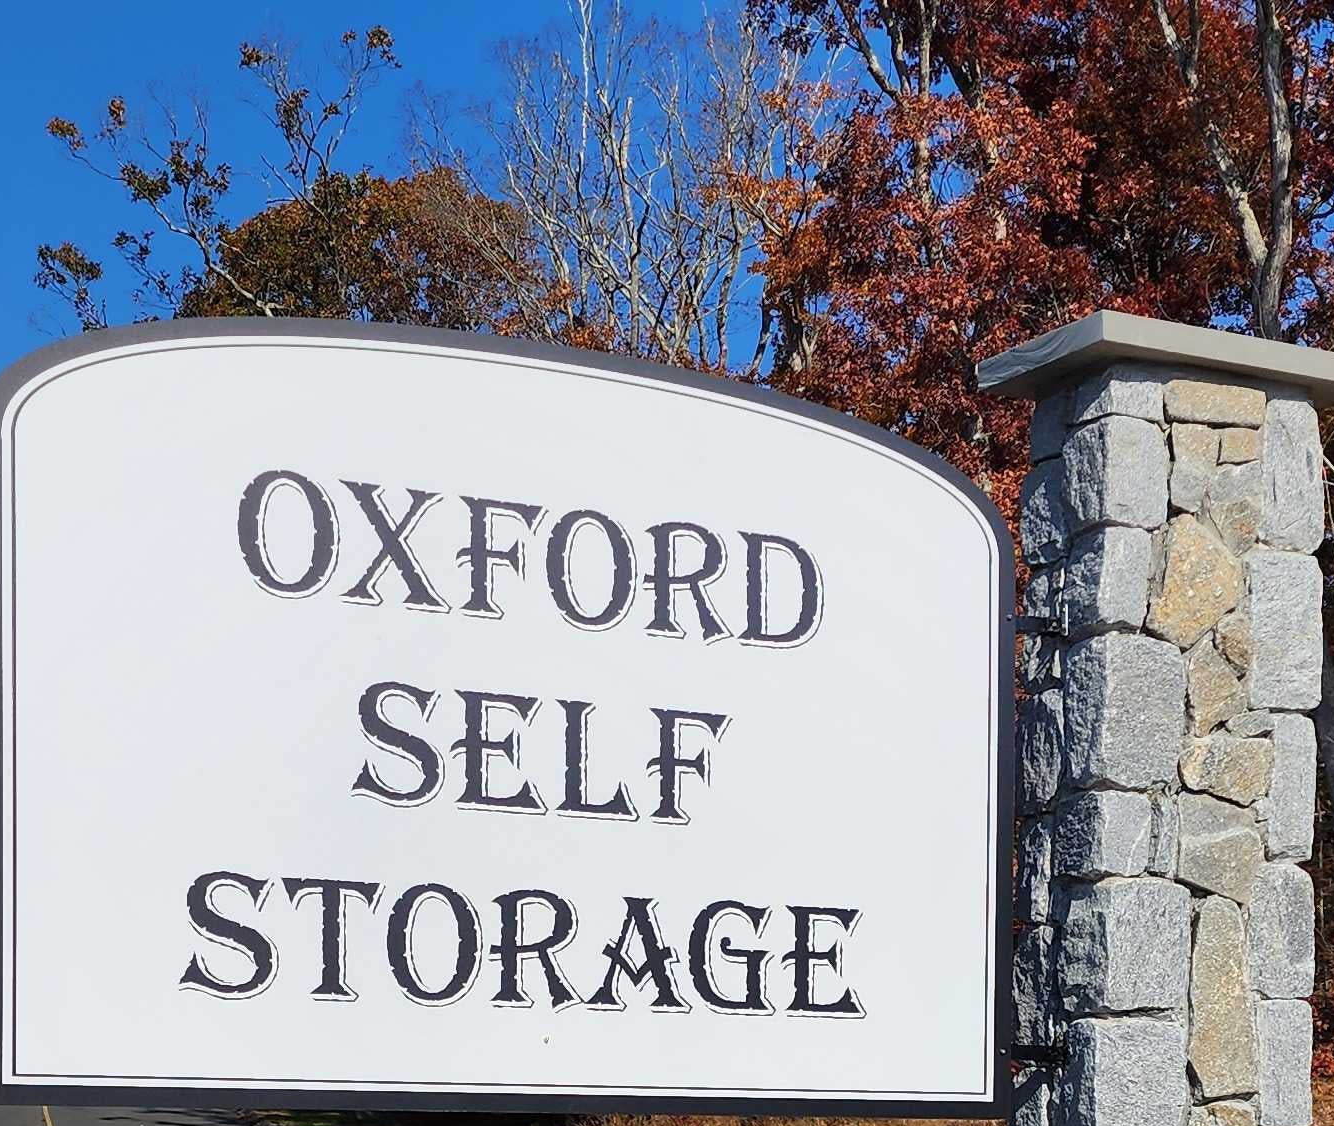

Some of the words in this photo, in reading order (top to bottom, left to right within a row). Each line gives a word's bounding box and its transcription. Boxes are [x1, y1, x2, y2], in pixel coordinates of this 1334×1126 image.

[236, 469, 825, 650] OXFORD
[350, 680, 734, 827] SELF
[178, 870, 868, 1020] STORAGE
